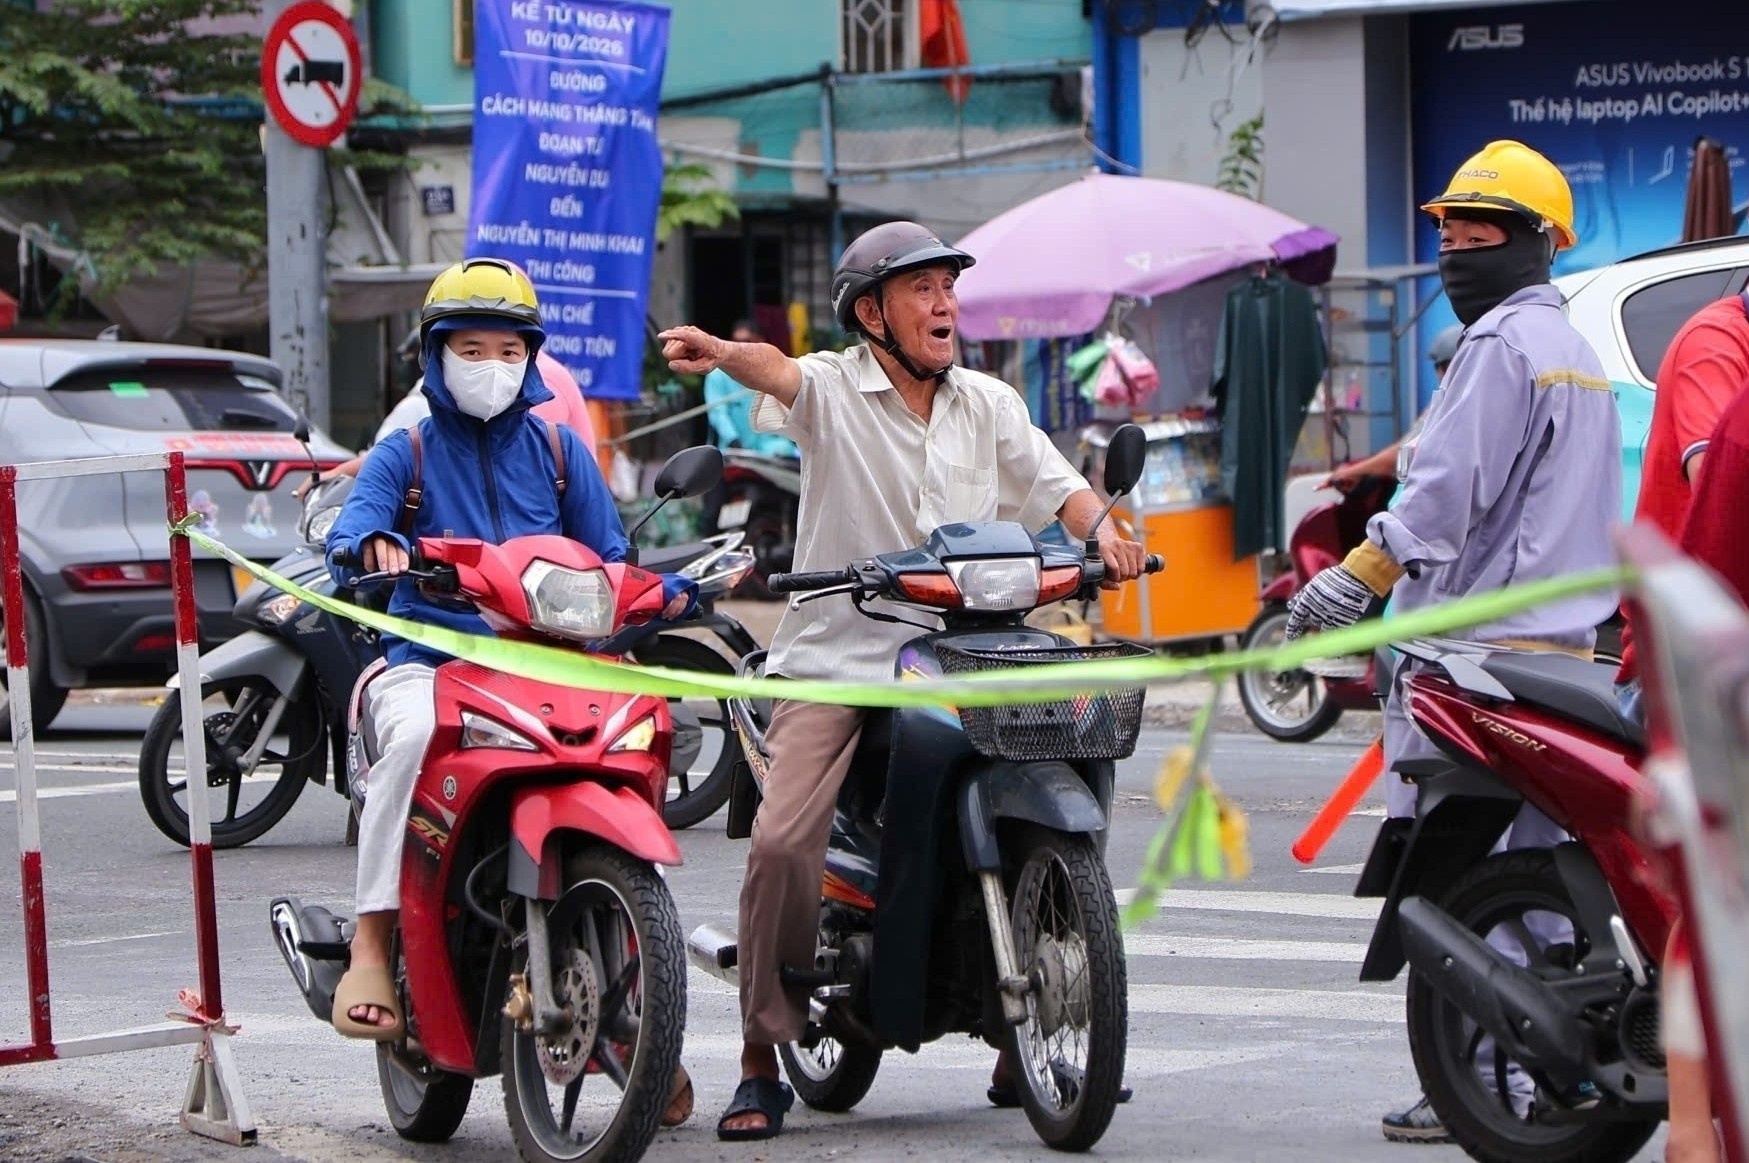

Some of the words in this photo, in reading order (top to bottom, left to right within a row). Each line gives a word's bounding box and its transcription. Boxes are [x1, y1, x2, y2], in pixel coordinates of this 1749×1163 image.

[577, 12, 635, 34] NGÀY
[1448, 23, 1524, 51] ASUS
[1576, 62, 1630, 87] ASUS
[1633, 57, 1725, 84] Vivobook
[1728, 55, 1741, 80] S
[482, 92, 526, 116] CÁCH
[575, 103, 626, 127] THÁNG
[1509, 97, 1545, 122] Thế
[1549, 97, 1573, 126] hệ
[1576, 97, 1639, 125] laptop
[1640, 92, 1663, 117] AI
[525, 162, 588, 185] NGUYỄN
[550, 194, 583, 218] ĐẾN
[477, 220, 539, 247] NGUYỄN
[543, 228, 564, 252] THỊ
[569, 233, 604, 250] MINH
[607, 236, 645, 255] KHAI
[526, 259, 549, 280] THI
[553, 260, 595, 284] CÔNG
[562, 302, 595, 326] CHẾ
[585, 336, 616, 358] TIỆN
[1472, 711, 1547, 751] VISION
